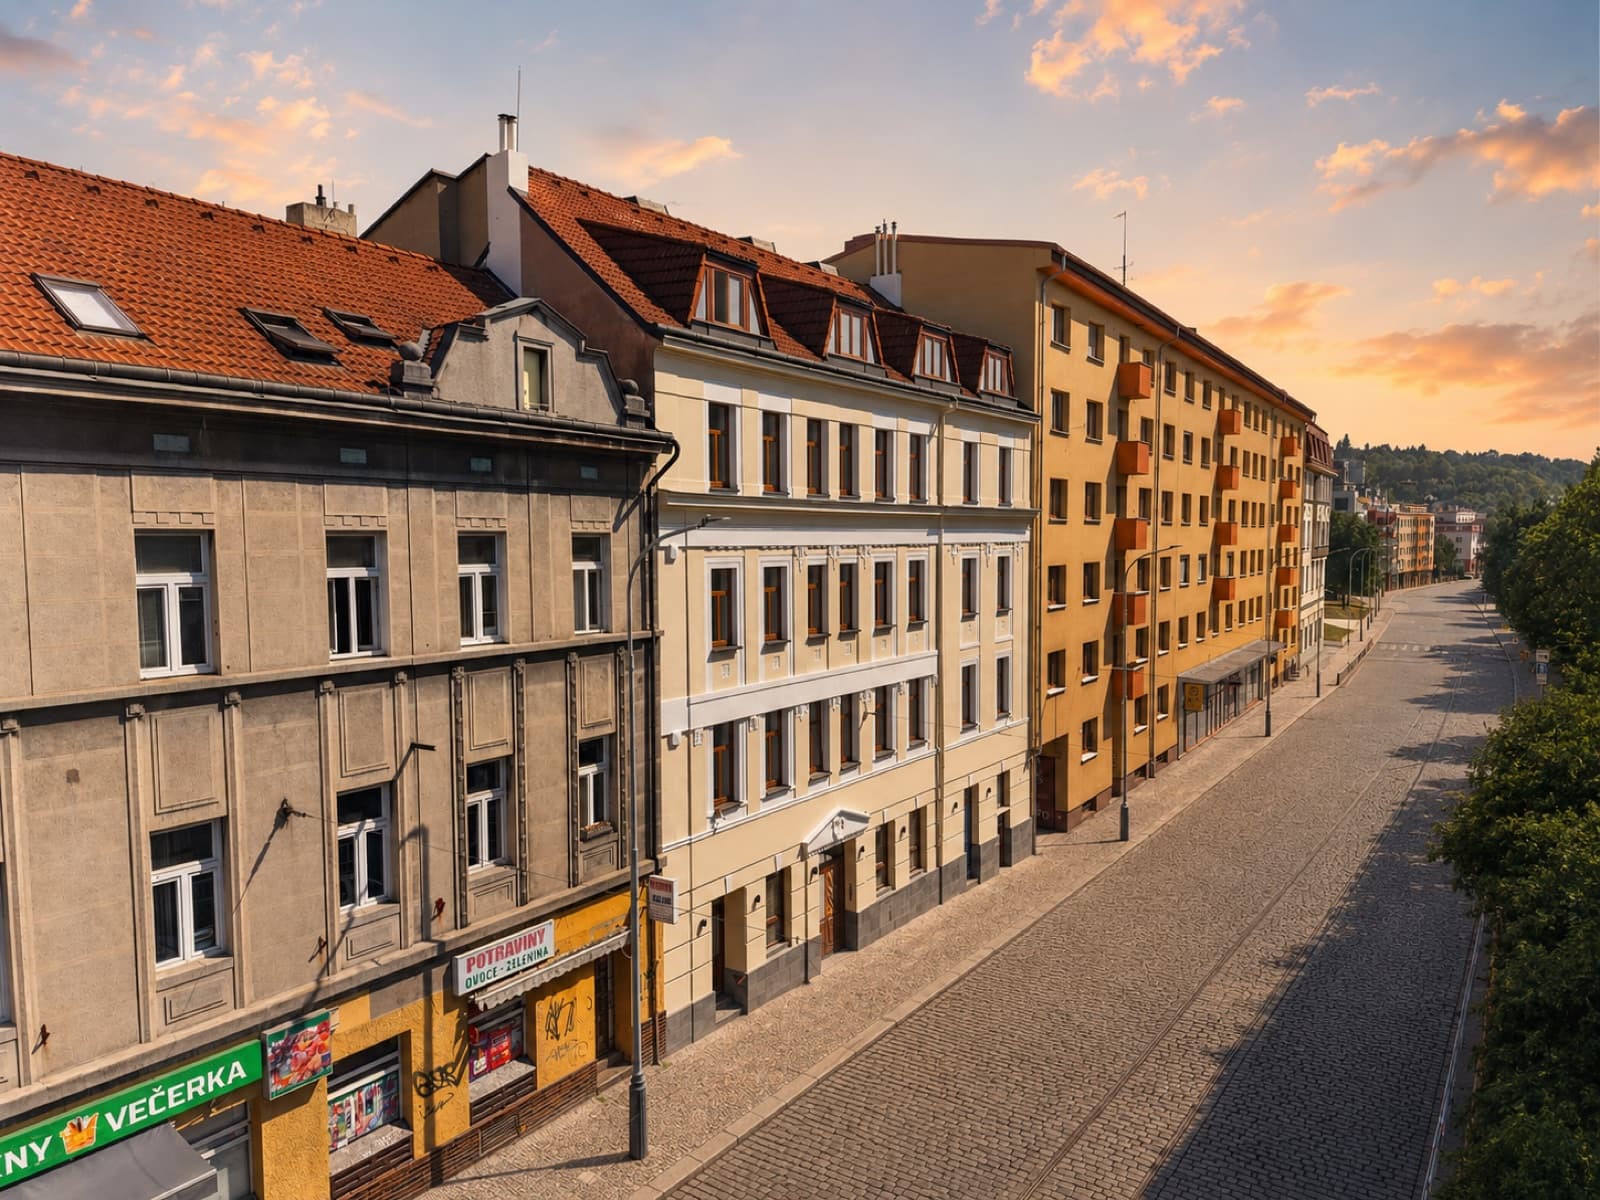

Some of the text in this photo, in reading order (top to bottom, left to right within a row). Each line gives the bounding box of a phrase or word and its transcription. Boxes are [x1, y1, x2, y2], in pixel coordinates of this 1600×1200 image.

[466, 928, 546, 973] POTRAVINY
[465, 966, 497, 989] OVOCE
[0, 1060, 247, 1177] NY VEČERKA
